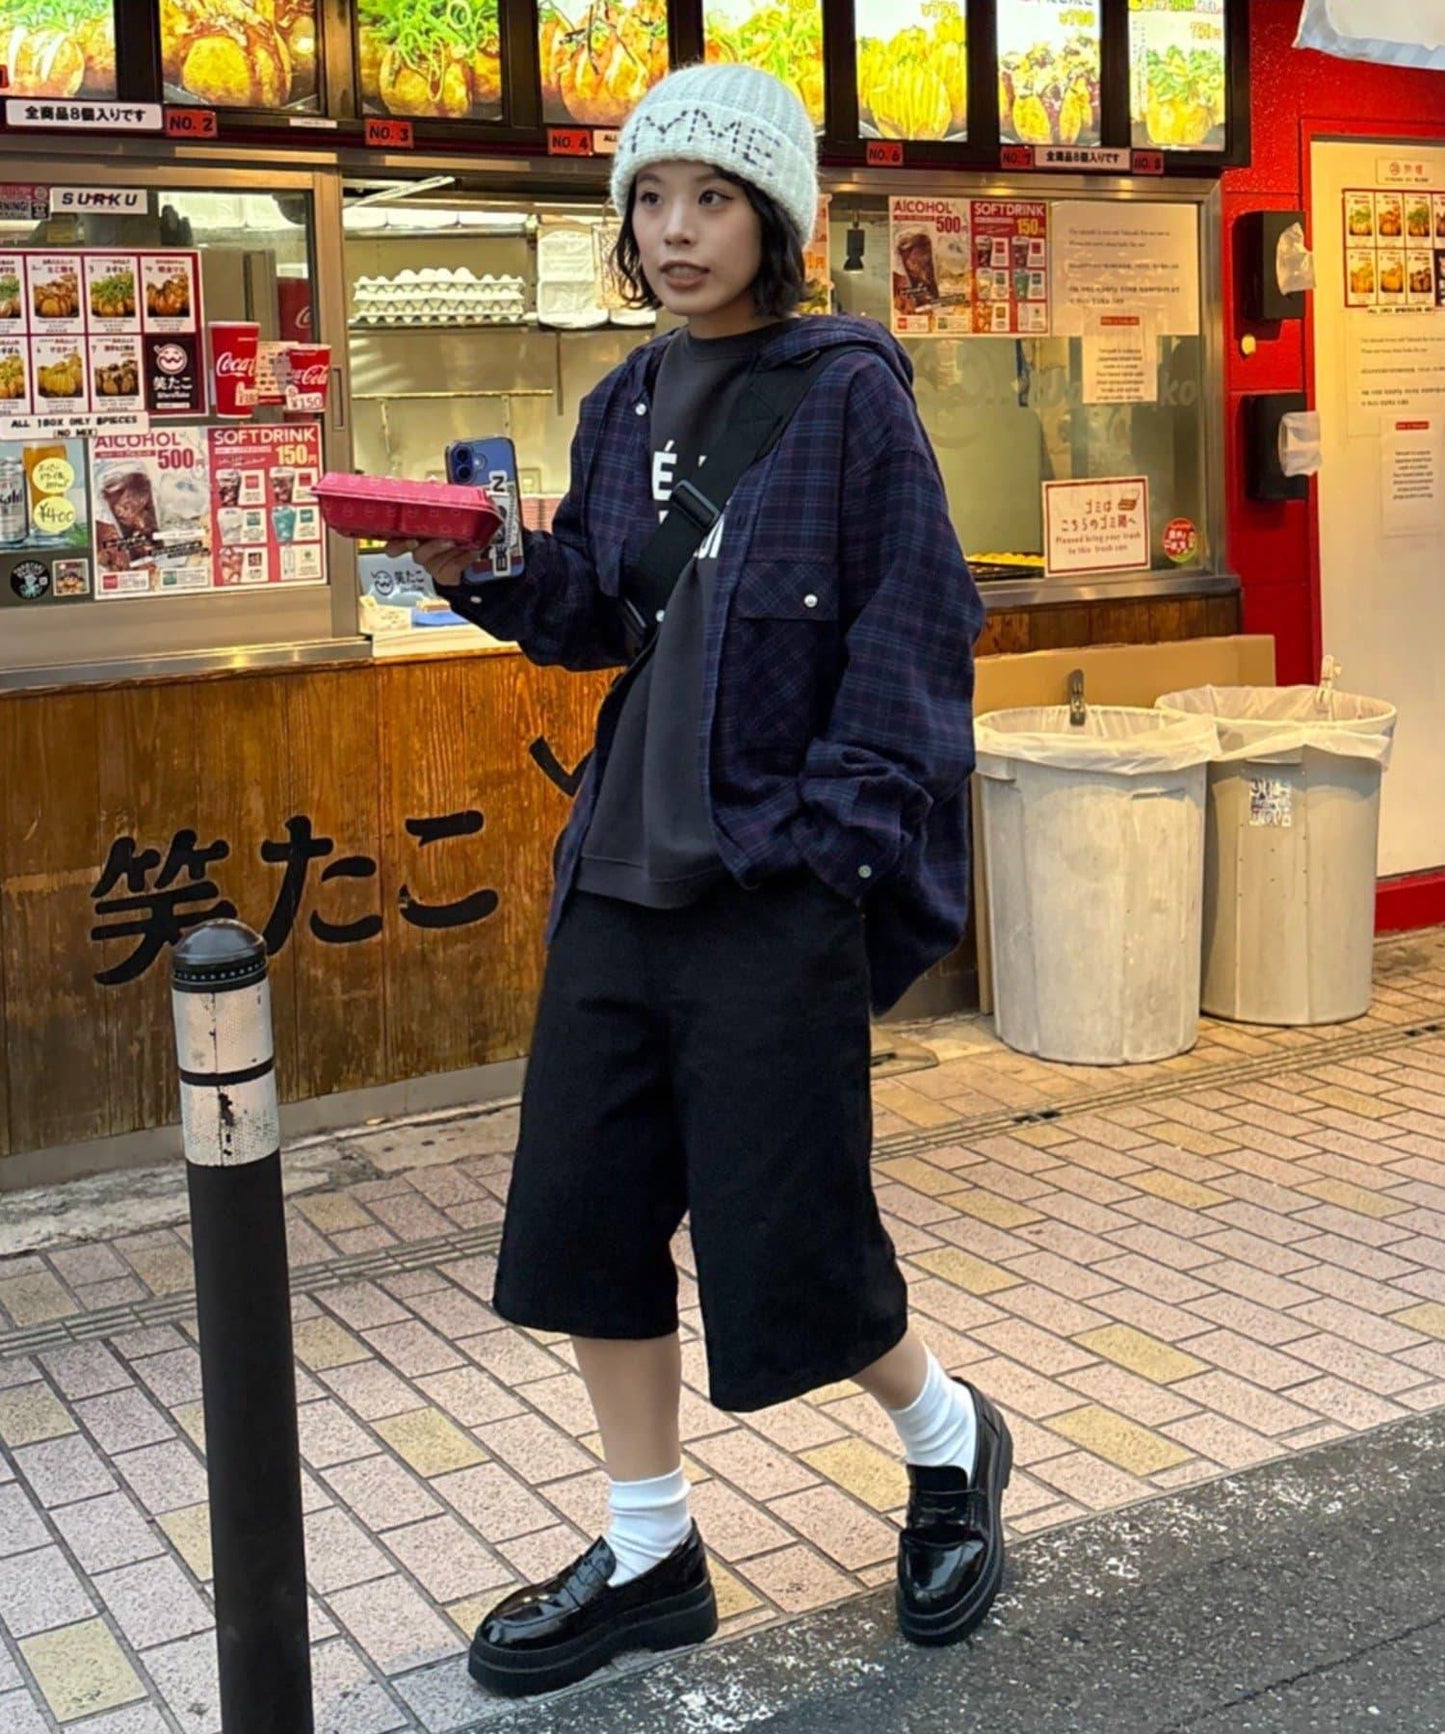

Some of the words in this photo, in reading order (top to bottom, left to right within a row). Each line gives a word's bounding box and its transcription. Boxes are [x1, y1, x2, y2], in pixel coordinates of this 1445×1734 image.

[25, 105, 146, 122] 全商品8個入りです
[169, 116, 196, 130] NO.
[203, 117, 213, 131] 2
[369, 126, 394, 139] NO.
[400, 127, 409, 141] 3
[579, 136, 587, 148] 4
[869, 150, 889, 162] NO.
[891, 151, 899, 163] 6
[153, 376, 193, 391] 笑たこ
[90, 809, 499, 986] 笑たこ
